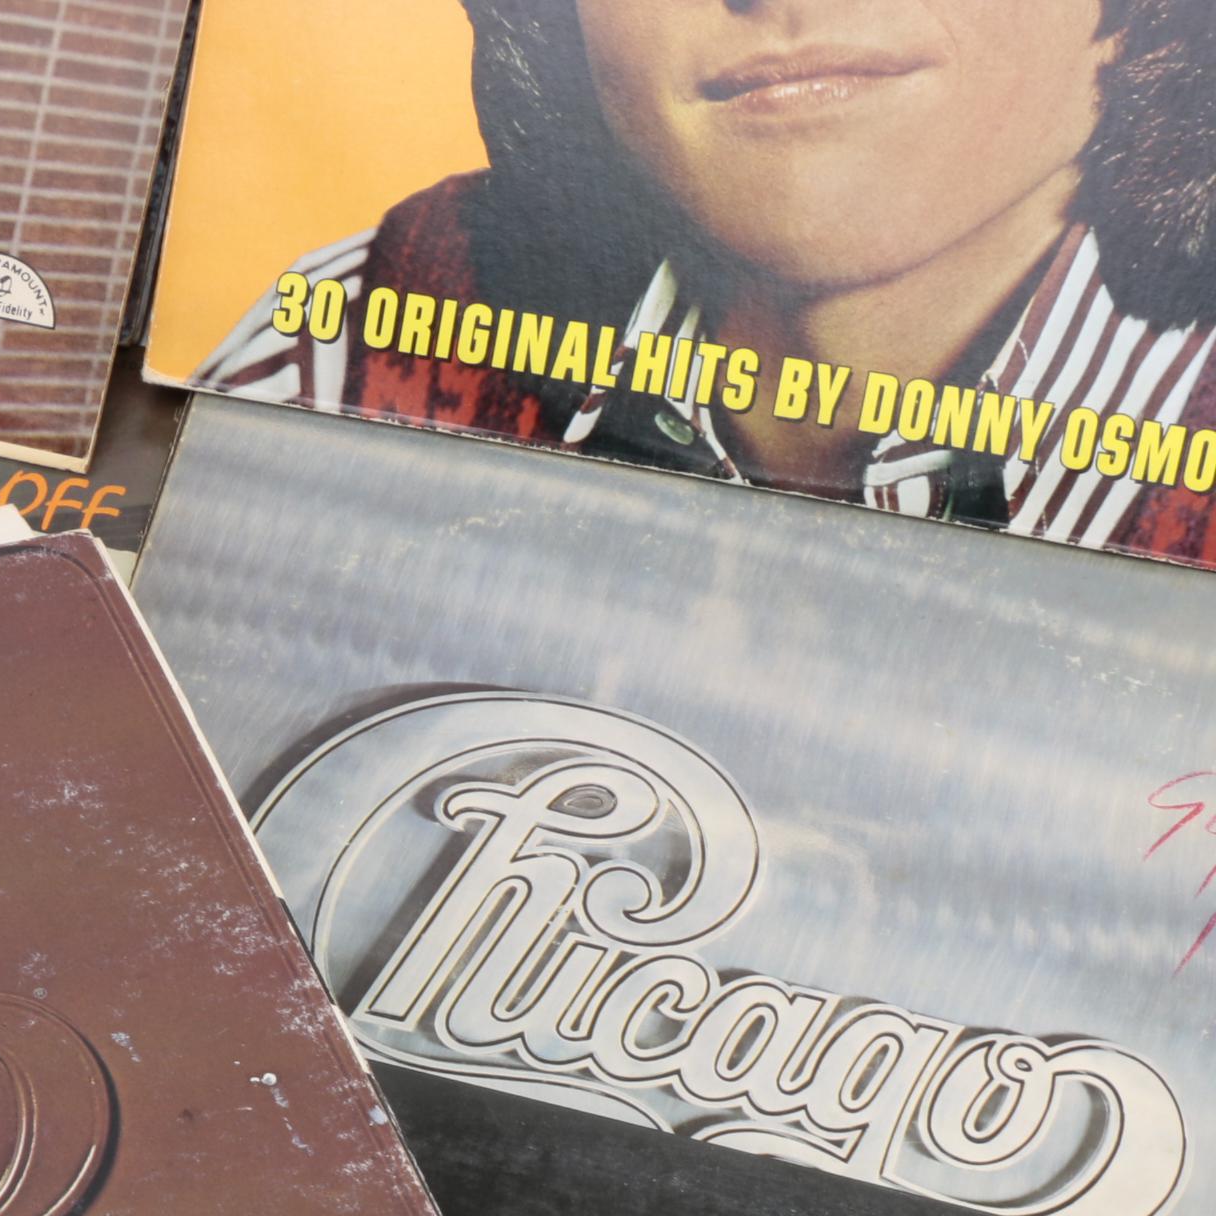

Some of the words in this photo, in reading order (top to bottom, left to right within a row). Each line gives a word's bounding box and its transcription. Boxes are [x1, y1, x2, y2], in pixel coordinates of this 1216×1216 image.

[271, 271, 347, 344] 30
[362, 285, 618, 388] ORIGINAL
[630, 332, 762, 412] HITS
[772, 356, 851, 427] BY
[858, 371, 1055, 462] DONNY
